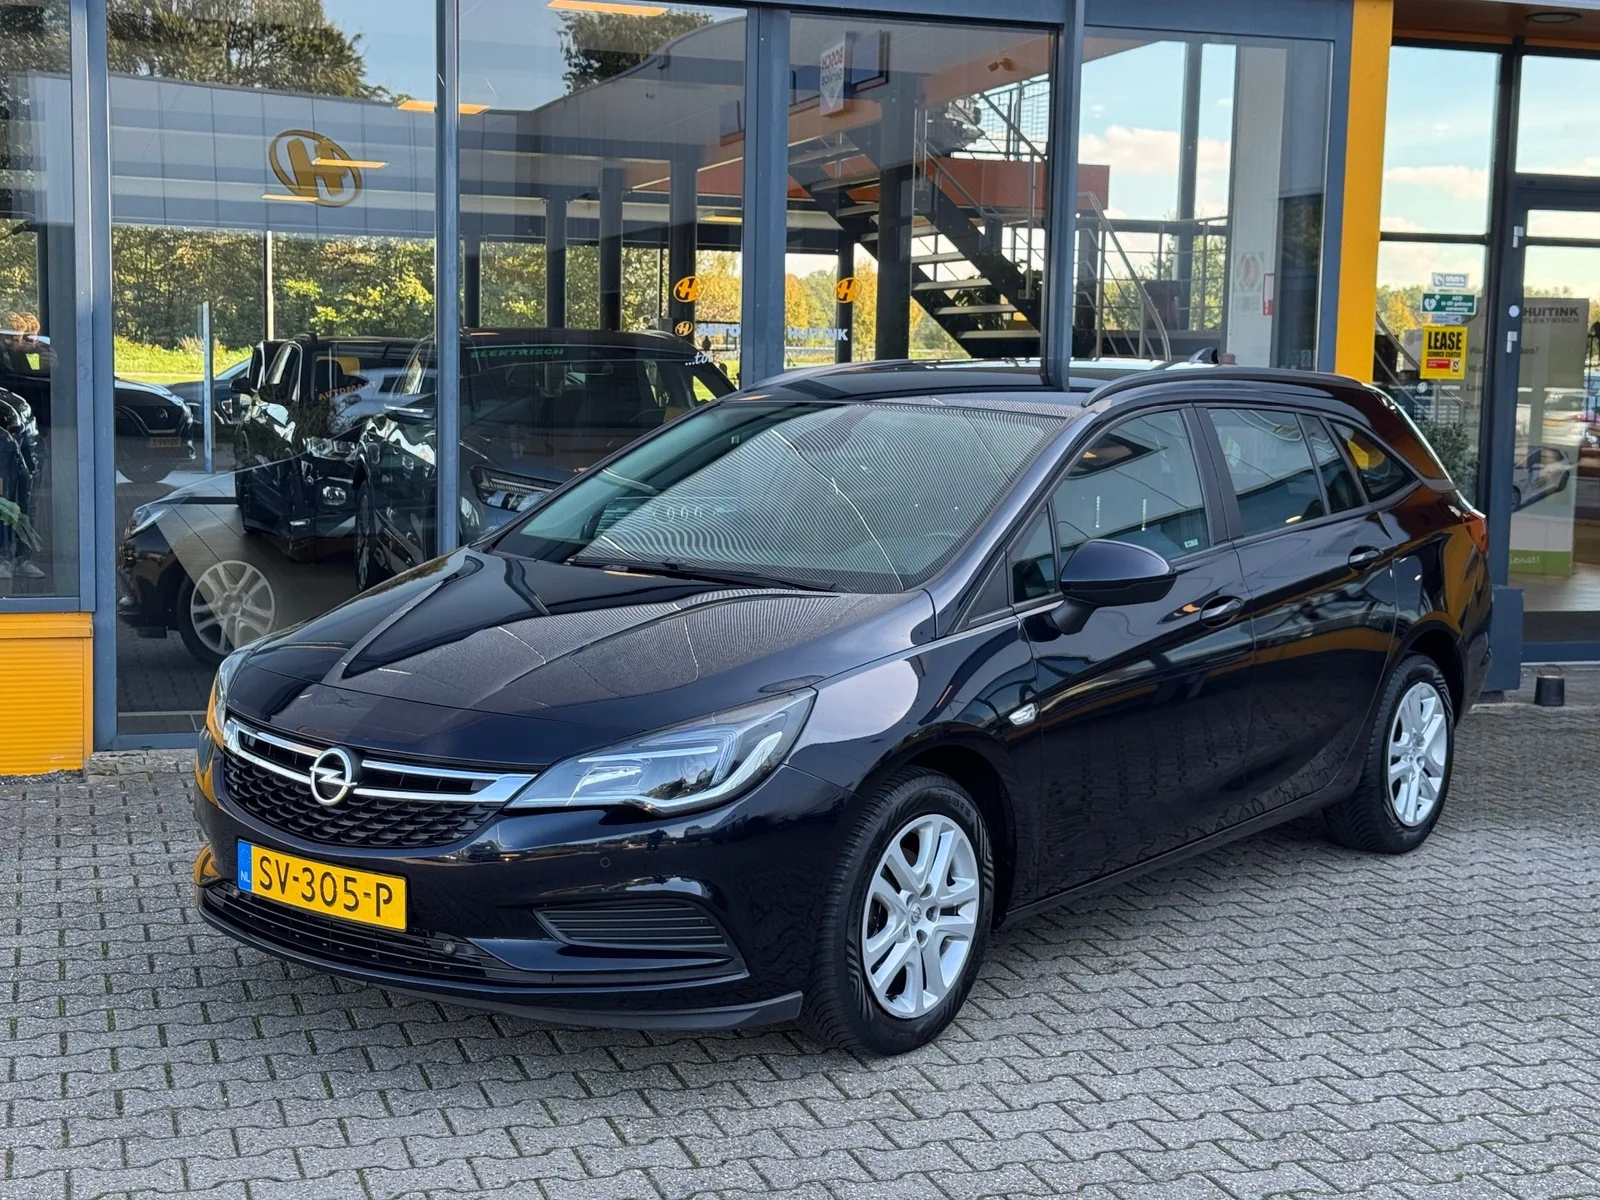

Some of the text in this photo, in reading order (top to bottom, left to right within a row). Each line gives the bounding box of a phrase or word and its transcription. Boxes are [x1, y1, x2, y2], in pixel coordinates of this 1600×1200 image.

[1524, 306, 1580, 317] HUITINK
[1427, 331, 1462, 350] LEASE
[470, 348, 564, 359] ELEKTRISCH
[240, 871, 251, 883] NL
[259, 855, 393, 917] SV-305-P
